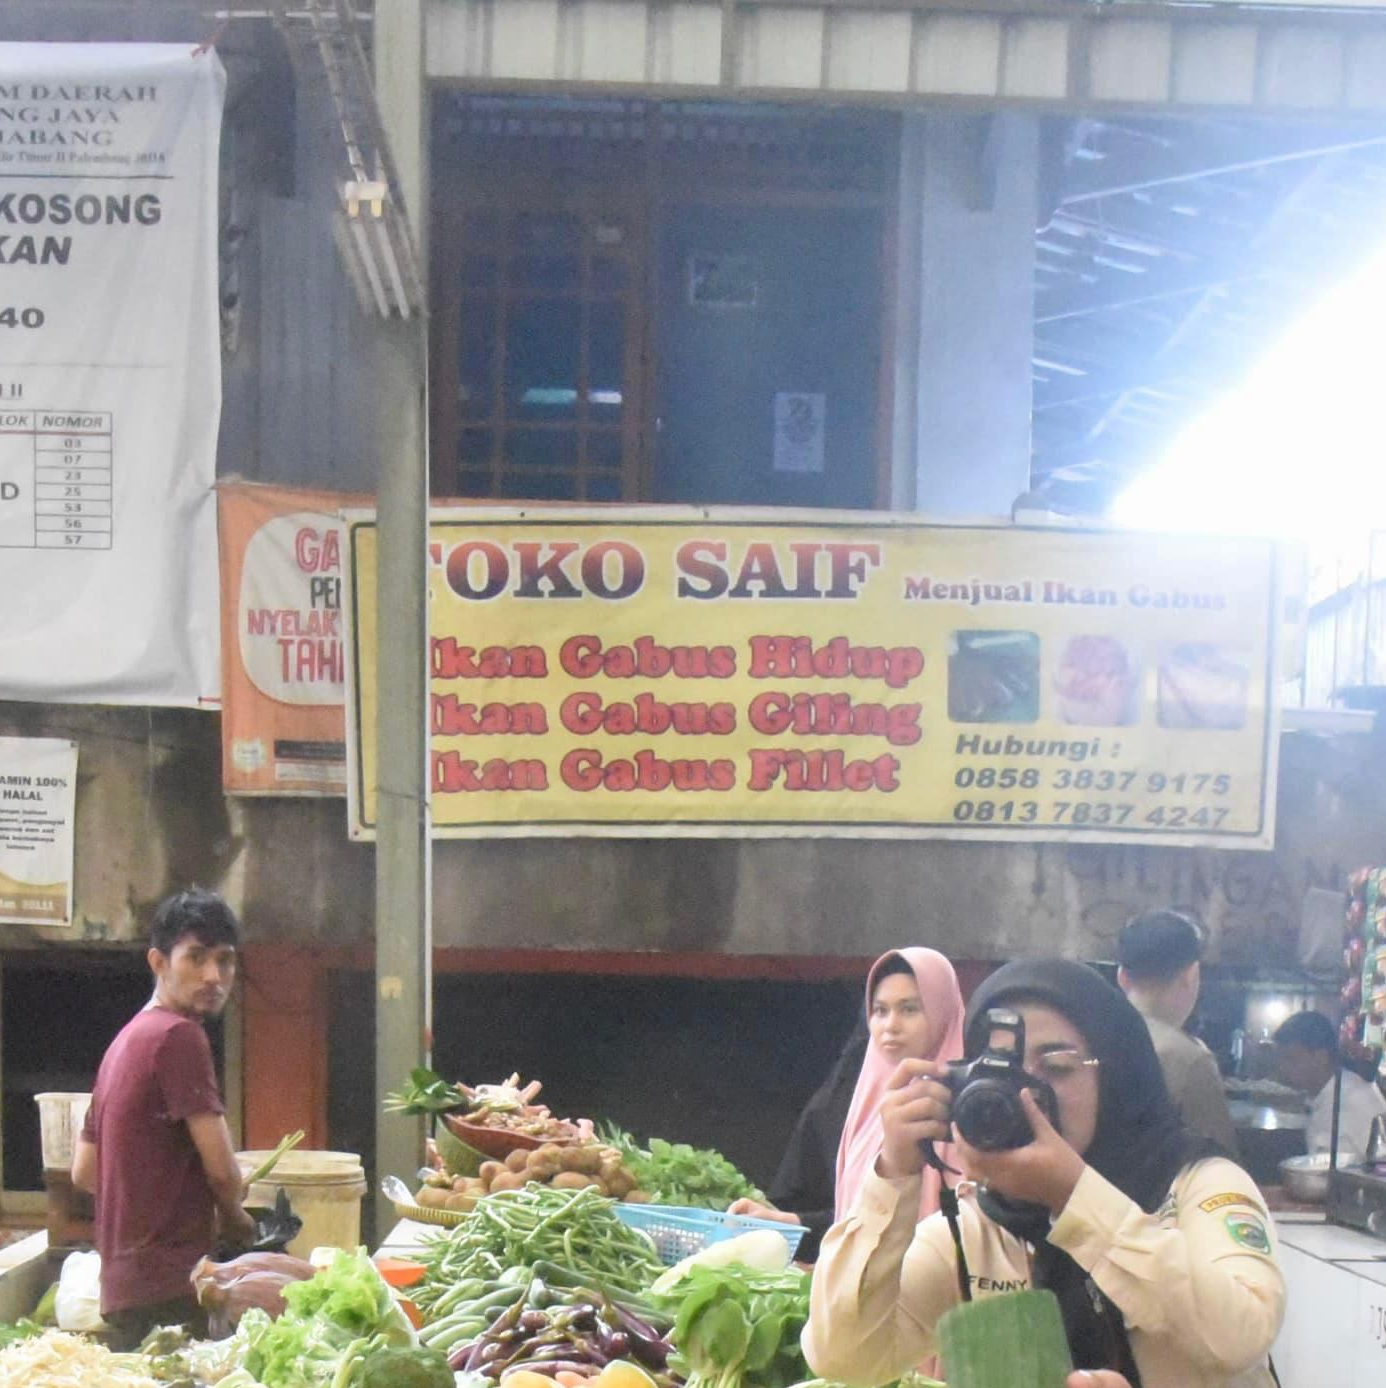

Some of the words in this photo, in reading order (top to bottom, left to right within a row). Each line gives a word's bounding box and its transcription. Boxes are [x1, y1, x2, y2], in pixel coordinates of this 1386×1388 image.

[31, 85, 158, 101] DAERAH
[48, 107, 121, 124] JAYA
[10, 384, 23, 398] II
[42, 415, 103, 428] NOMOR
[0, 481, 20, 501] D
[295, 527, 341, 573] GA
[676, 540, 881, 601] SAIF
[903, 576, 1032, 606] Menjual
[1043, 581, 1117, 606] Ikan
[1128, 584, 1228, 609] Gabus
[310, 576, 341, 610] PE
[430, 636, 548, 679] Ikan
[559, 634, 737, 680] Gabus
[747, 635, 925, 689] Hidup
[430, 692, 549, 736] Ikan
[559, 691, 737, 736] Gabus
[747, 691, 923, 746] Giling
[955, 733, 1102, 762] Hubungi
[35, 776, 68, 788] 100%
[430, 750, 549, 793] Ikan
[559, 748, 737, 793] Gabus
[747, 748, 901, 793] Fillet
[954, 767, 1041, 790] 0858
[1052, 768, 1137, 792] 3837
[1146, 773, 1231, 796] 9175
[2, 789, 44, 801] HALAL
[953, 800, 1039, 823] 0813
[1052, 802, 1135, 825] 7837
[1144, 805, 1230, 829] 4247
